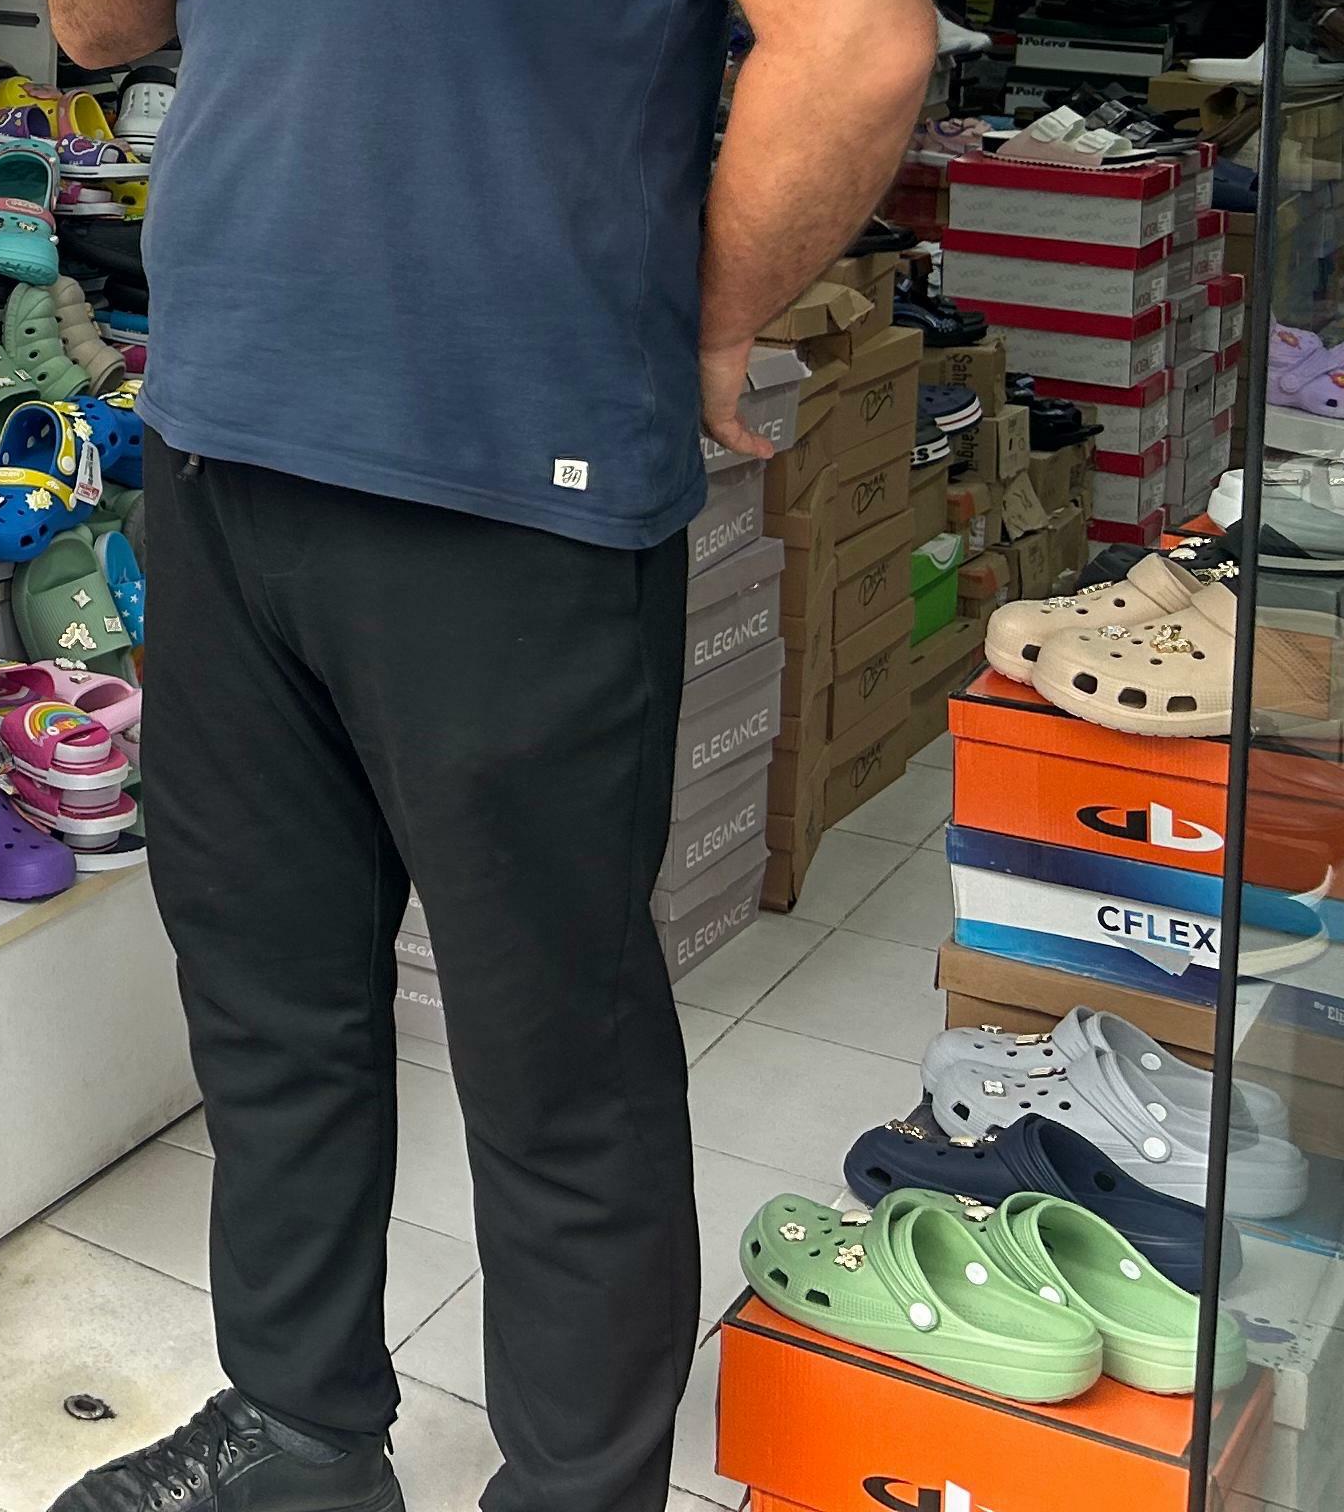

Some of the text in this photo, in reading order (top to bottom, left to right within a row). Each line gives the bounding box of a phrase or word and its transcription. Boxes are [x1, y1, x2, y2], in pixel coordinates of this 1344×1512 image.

[695, 507, 755, 562] ELEGANCE
[694, 610, 769, 666] ELEGANCE
[692, 710, 769, 769] ELEGANCE
[686, 804, 756, 868] ELEGANCE
[677, 897, 753, 965] ELEGANCE
[1097, 905, 1218, 954] CFLEX
